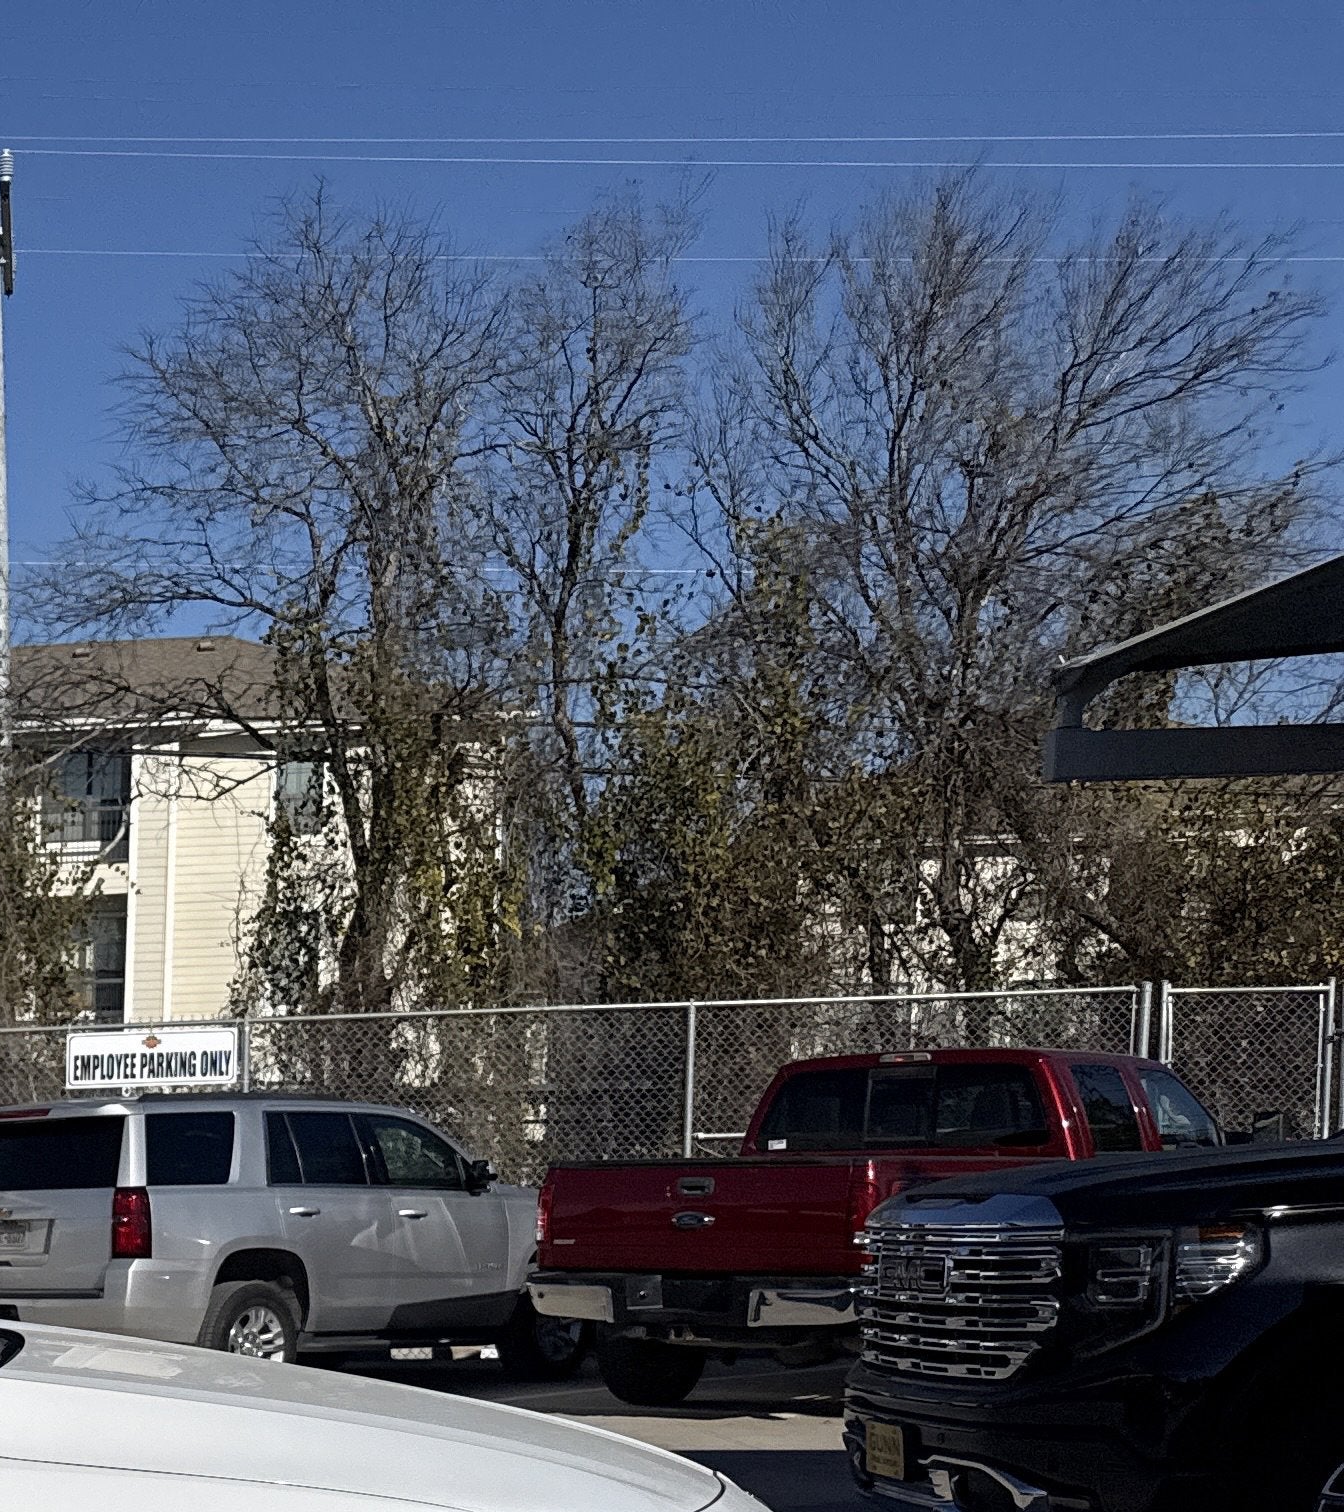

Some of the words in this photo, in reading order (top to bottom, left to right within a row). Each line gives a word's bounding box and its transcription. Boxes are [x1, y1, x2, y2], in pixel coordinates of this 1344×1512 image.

[73, 1053, 137, 1081] EMPLOYEE
[140, 1051, 196, 1079] PARKING
[200, 1050, 232, 1077] ONLY
